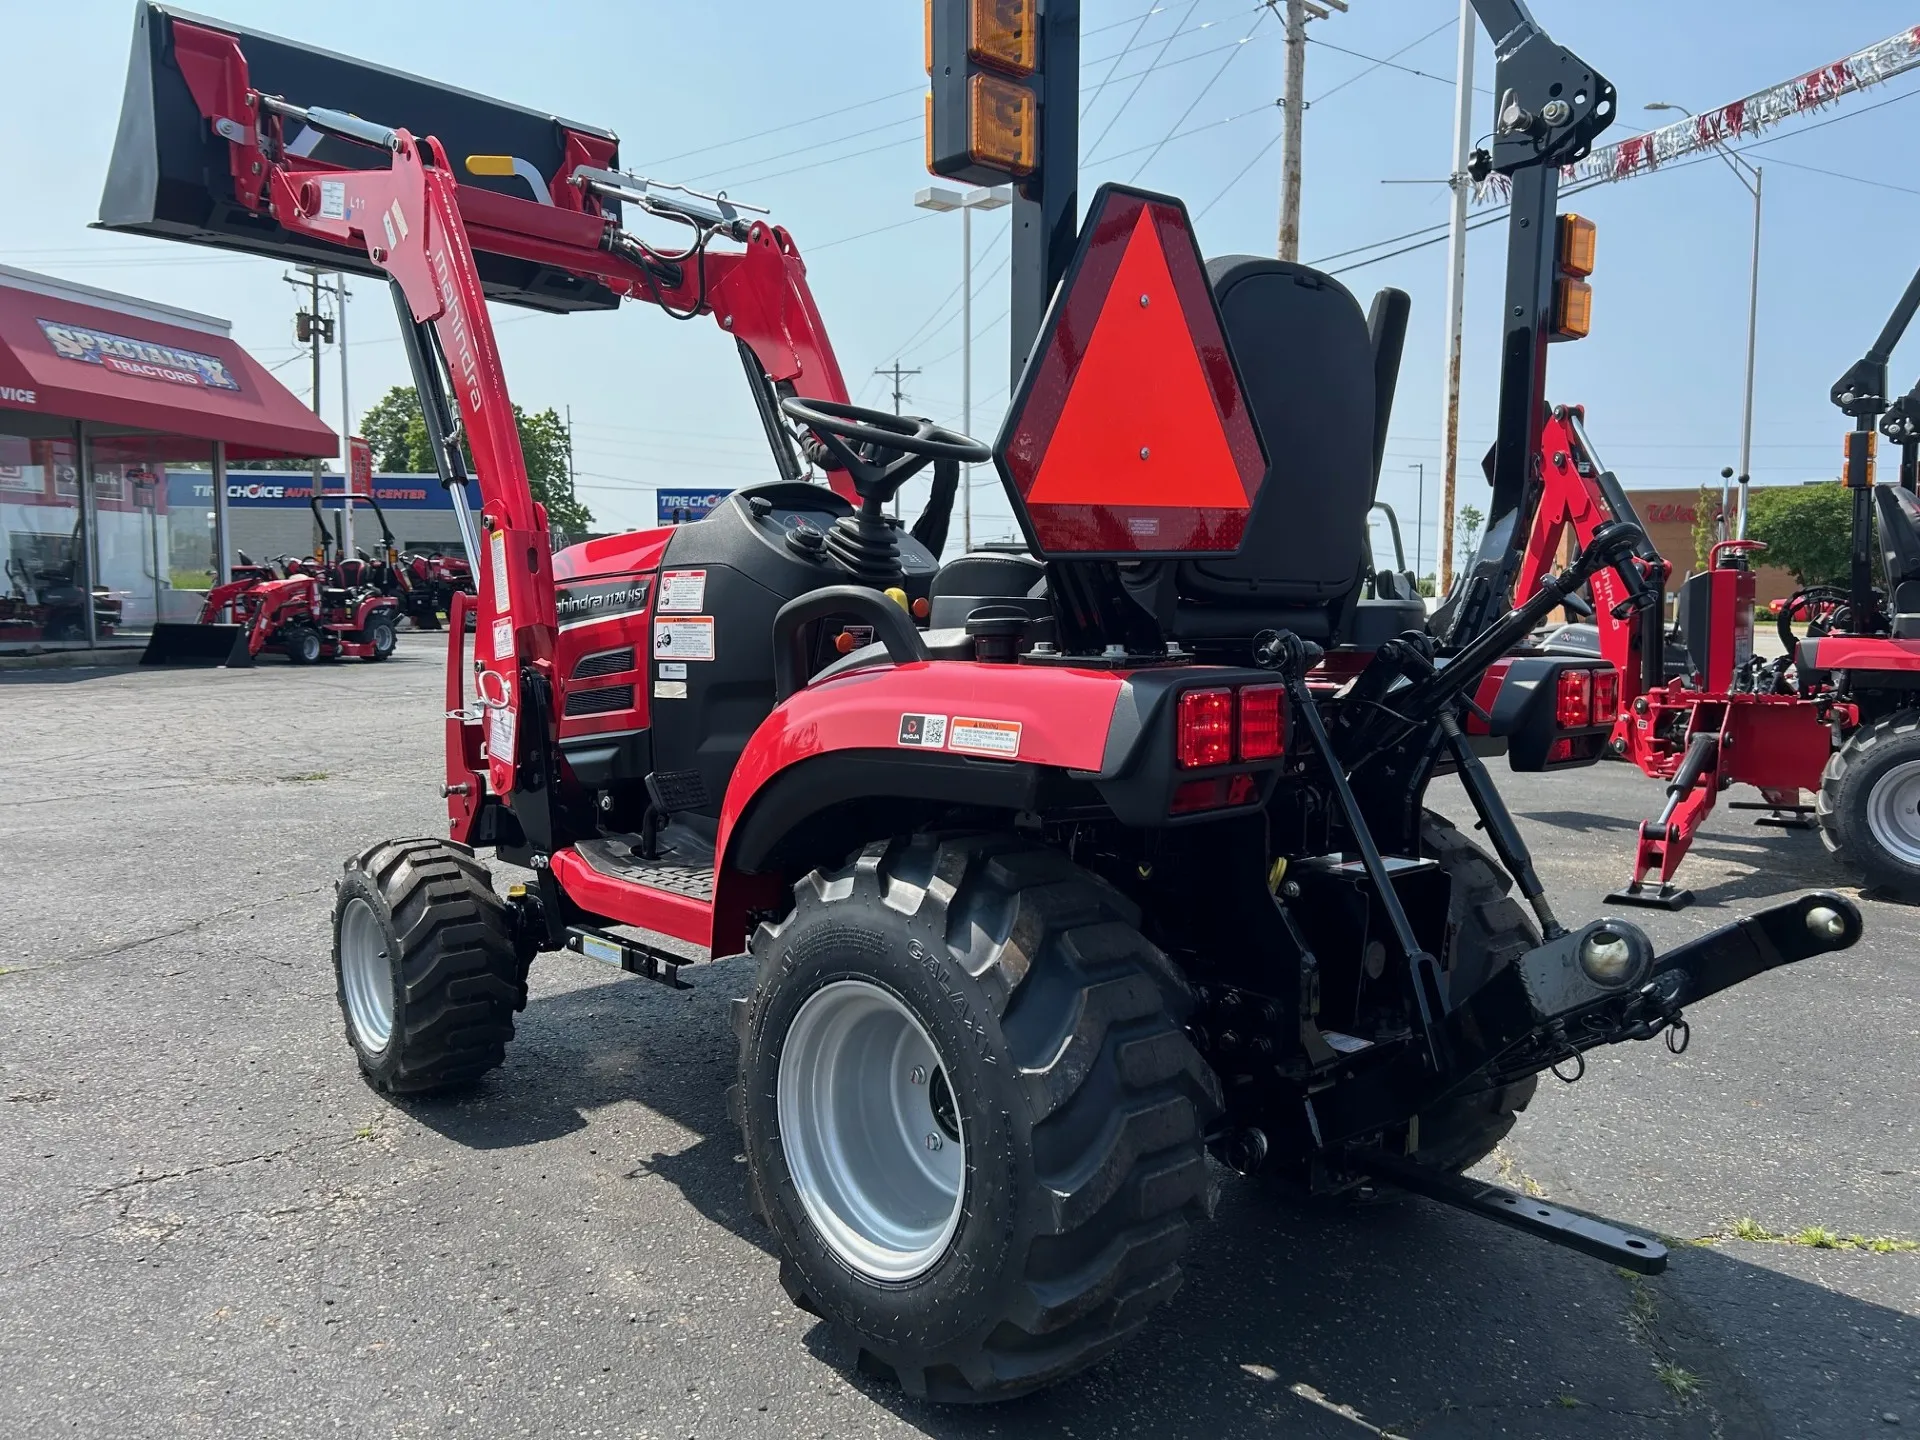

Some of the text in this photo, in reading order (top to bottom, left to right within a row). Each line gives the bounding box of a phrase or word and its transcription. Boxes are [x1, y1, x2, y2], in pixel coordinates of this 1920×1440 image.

[350, 196, 365, 210] L11
[434, 248, 482, 413] mahindra
[46, 326, 229, 385] SPECIALTY
[108, 357, 198, 385] TRACTORS
[0, 386, 37, 404] VICE
[192, 485, 215, 497] TIR
[227, 484, 284, 499] CHOICE
[377, 488, 427, 500] CENTER
[556, 593, 604, 615] ahindra
[1601, 567, 1620, 631] ahinda
[906, 938, 997, 1065] GALAXY
